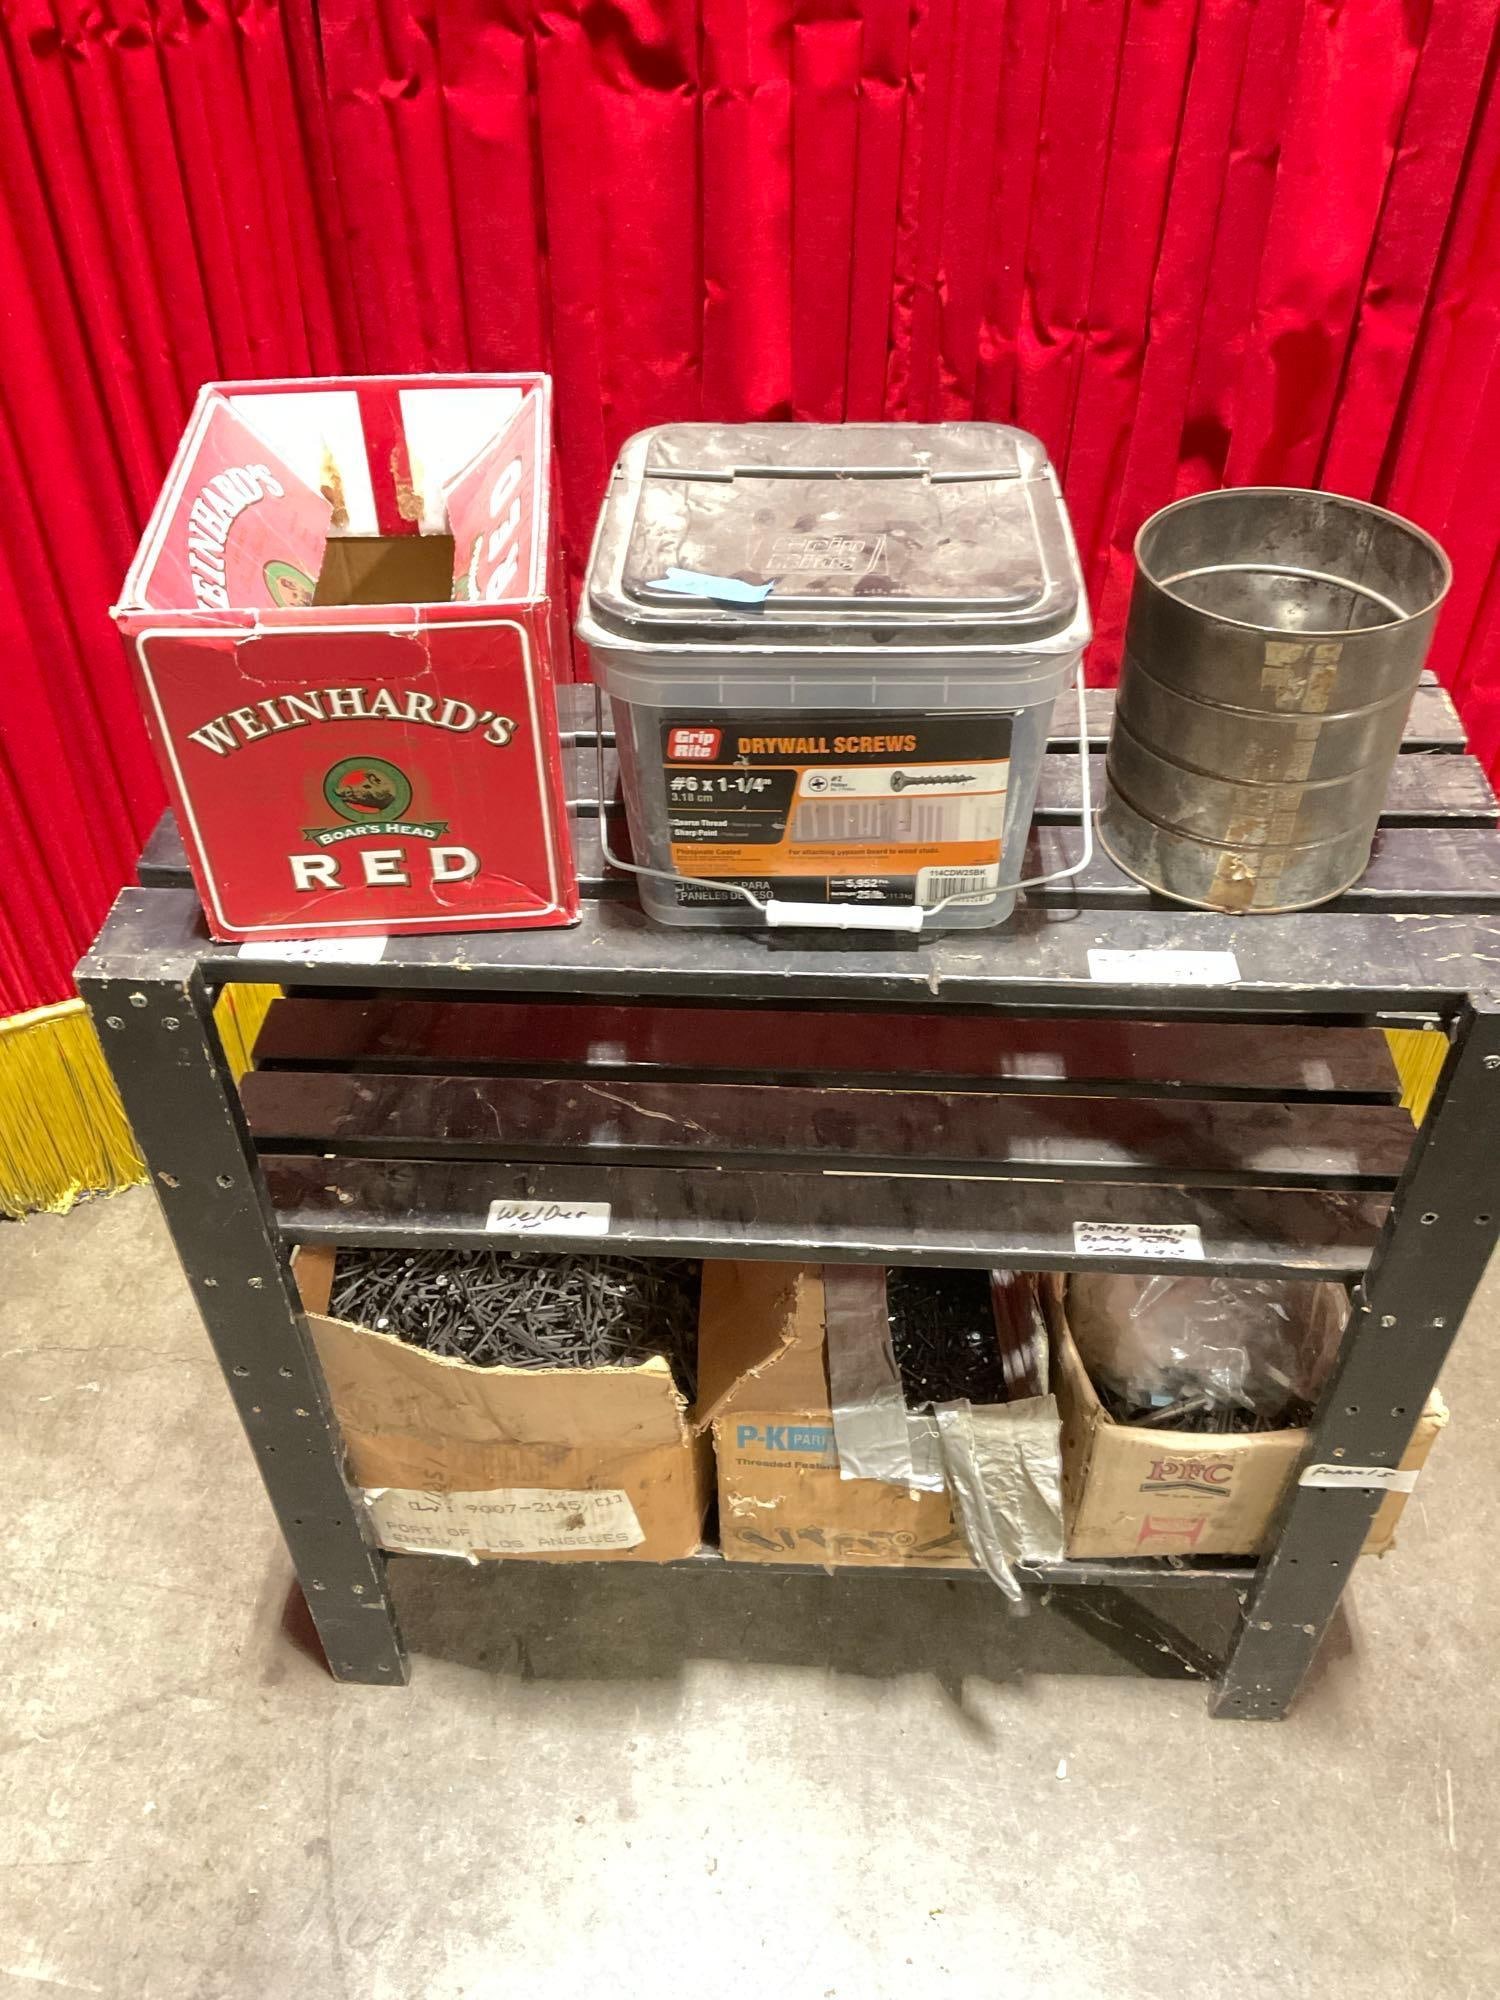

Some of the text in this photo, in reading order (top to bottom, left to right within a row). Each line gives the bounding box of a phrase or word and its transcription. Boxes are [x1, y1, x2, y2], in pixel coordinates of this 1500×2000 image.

[187, 686, 518, 759] WEINHARD'S
[674, 730, 715, 745] Grip
[673, 744, 712, 757] Rite
[737, 735, 917, 755] DRYWALL SCREWS
[670, 776, 699, 791] #6
[671, 792, 713, 802] 3.18 cm
[701, 819, 728, 827] Thread
[318, 822, 436, 846] BOAR'S HEAD
[674, 829, 697, 837] Sharp
[288, 845, 481, 892] RED
[740, 881, 771, 890] PARA
[680, 891, 728, 901] PANELES
[736, 1458, 792, 1468] Threaded
[447, 1528, 471, 1537] OF
[486, 1539, 525, 1549] LOS
[538, 1532, 630, 1548] ANGELES
